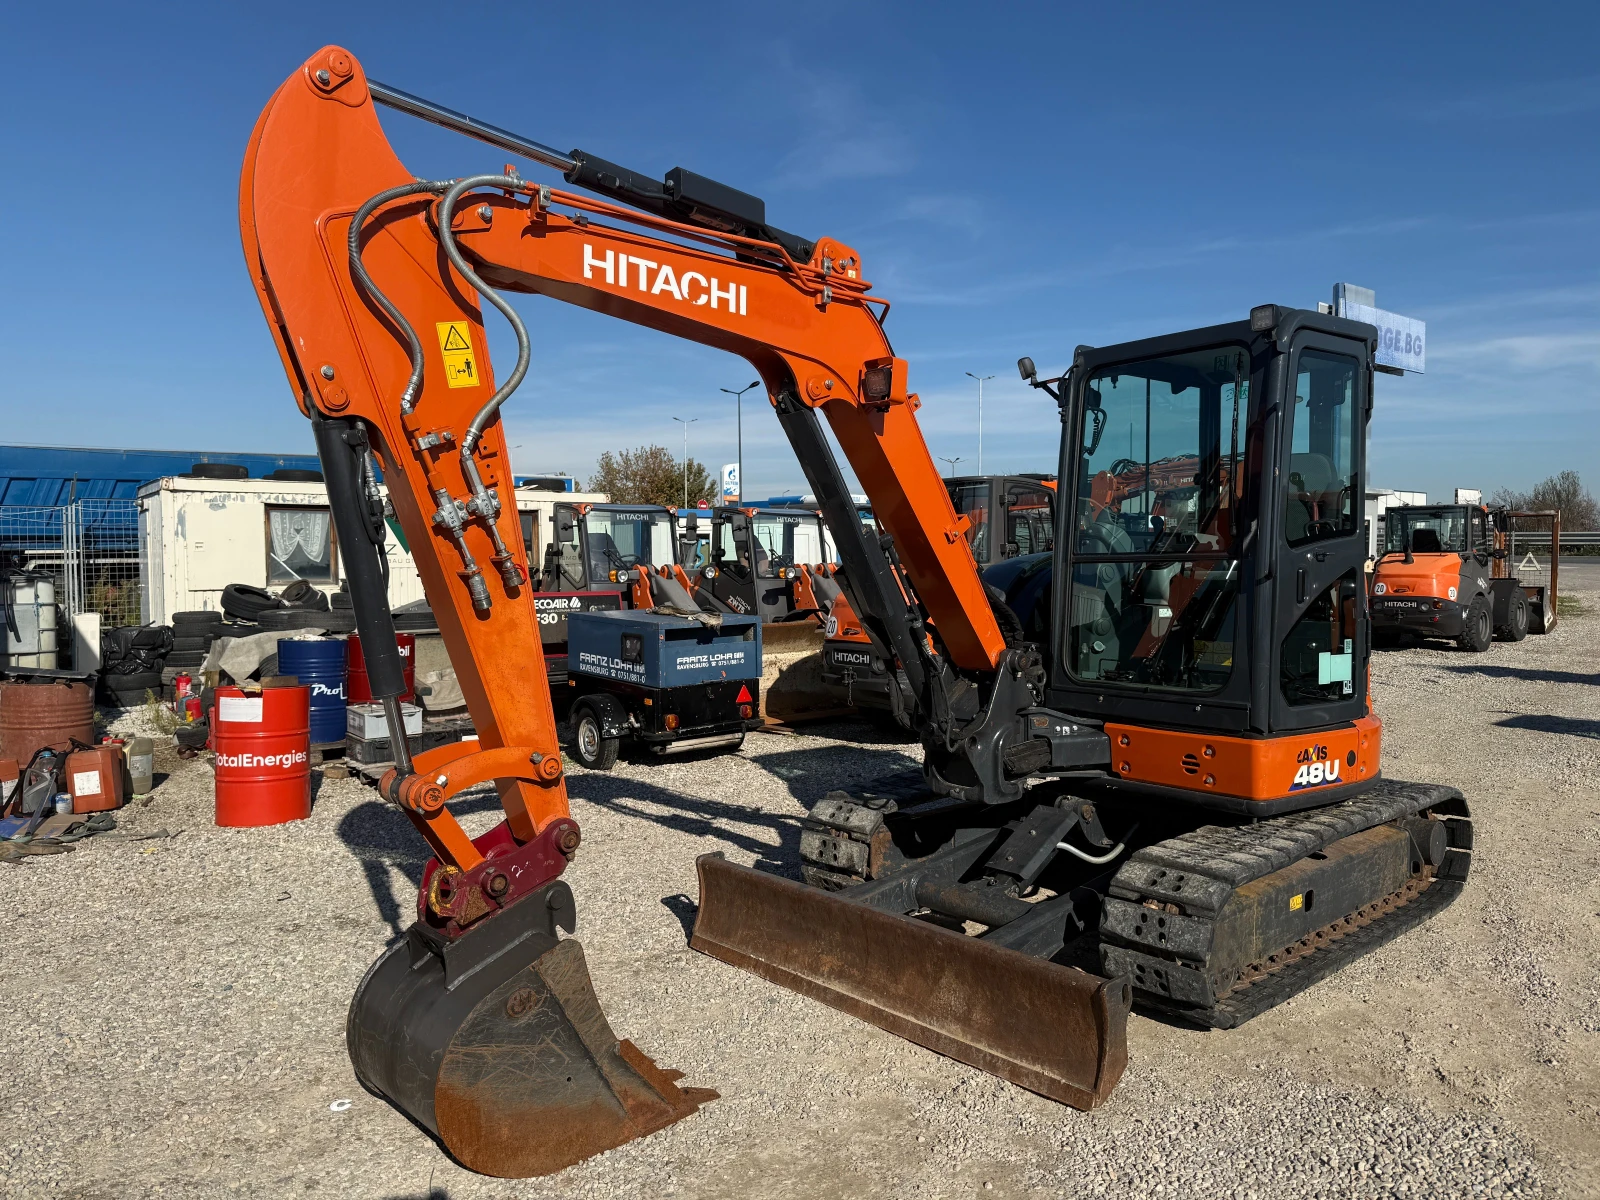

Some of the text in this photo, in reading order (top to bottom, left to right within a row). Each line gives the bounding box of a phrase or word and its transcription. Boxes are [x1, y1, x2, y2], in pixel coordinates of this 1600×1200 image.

[583, 243, 747, 316] HITACHI
[616, 513, 649, 521] HITACHI
[1375, 584, 1385, 593] 20
[1449, 589, 1456, 598] 20
[533, 599, 569, 609] ECOAIR
[727, 595, 746, 614] ZW75
[735, 595, 751, 611] HITACHI
[827, 620, 836, 635] 20
[579, 652, 608, 667] FRANZ
[609, 658, 633, 672] LOHR
[676, 655, 708, 665] FRANZ
[709, 652, 733, 661] LOHR
[834, 652, 870, 664] HITACHI
[579, 662, 646, 683] RAVENSBURG 0751/881-0
[676, 662, 709, 670] RAVENSBURG
[215, 750, 307, 769] TotalEnergies
[1293, 759, 1340, 786] 48U
